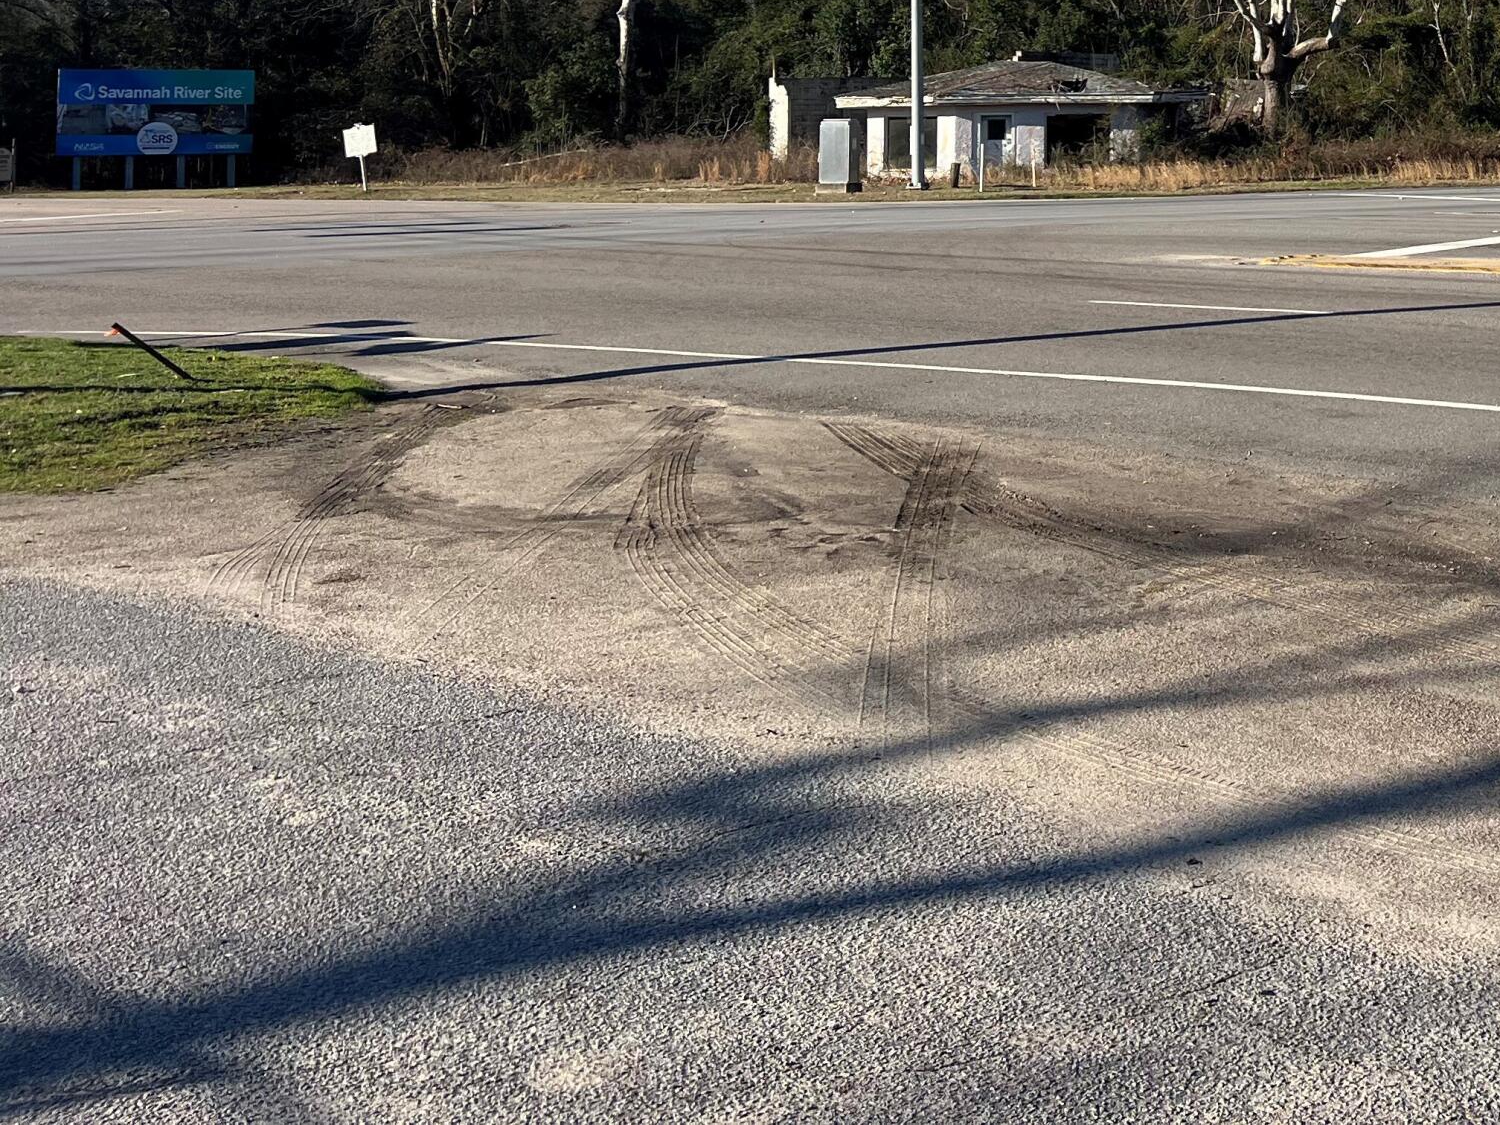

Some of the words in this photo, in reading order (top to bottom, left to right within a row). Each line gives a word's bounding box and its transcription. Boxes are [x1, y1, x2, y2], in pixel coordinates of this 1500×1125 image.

[97, 86, 170, 99] Savannah
[174, 86, 211, 99] River
[214, 86, 242, 99] Site
[151, 135, 173, 144] SRS
